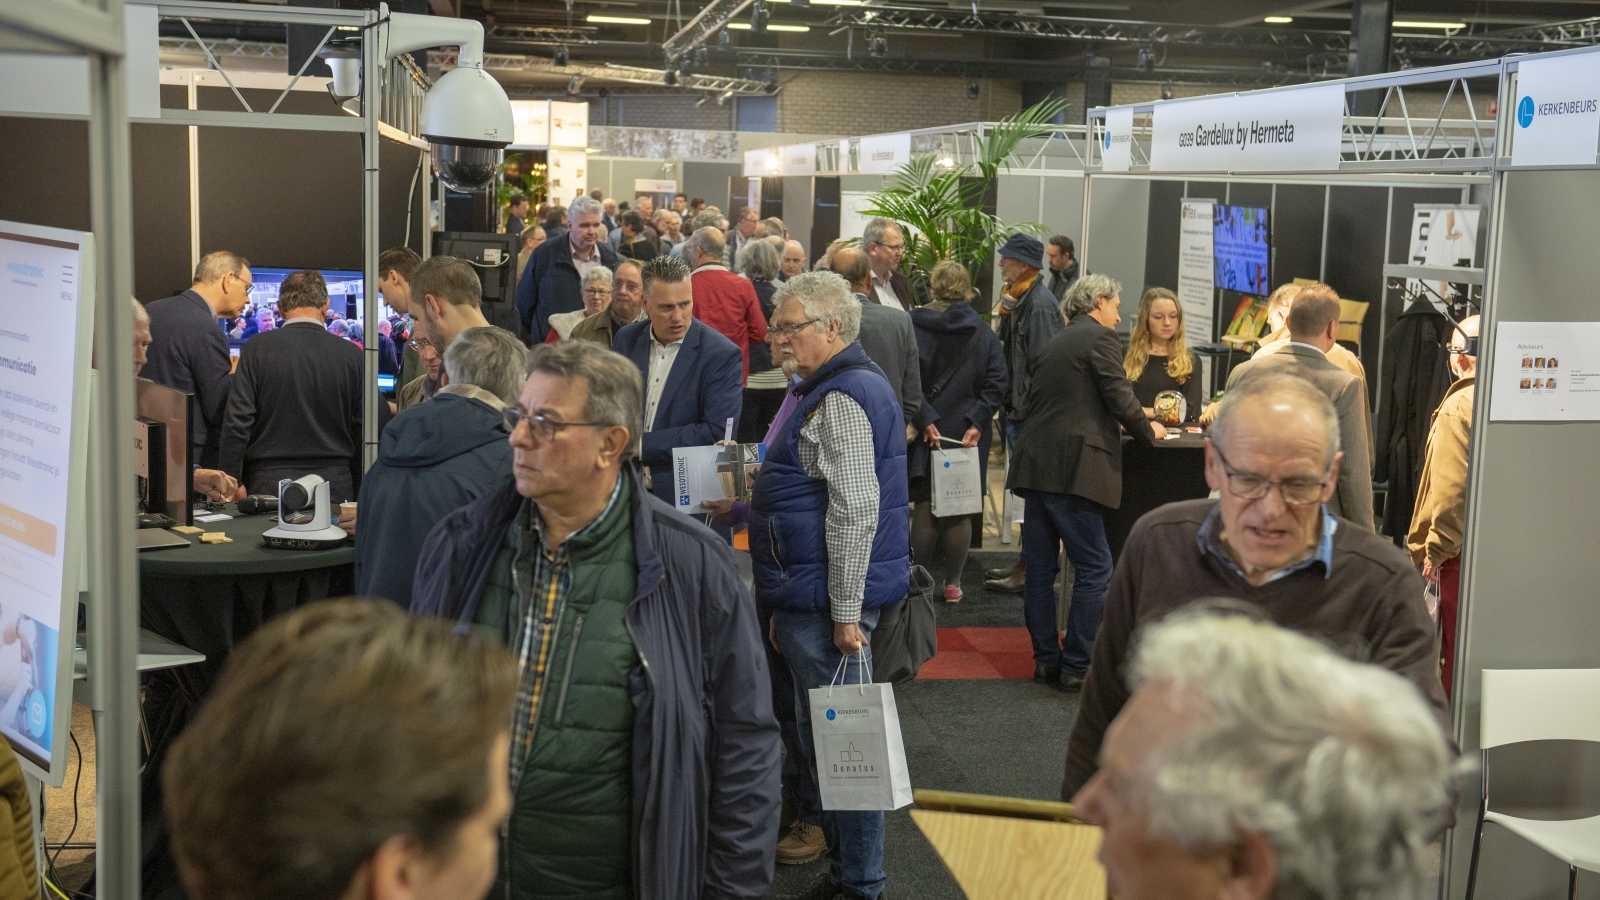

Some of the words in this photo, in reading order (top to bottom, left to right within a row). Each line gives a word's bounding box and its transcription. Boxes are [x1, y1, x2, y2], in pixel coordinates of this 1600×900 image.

[1538, 100, 1597, 116] KERKENBEURS
[1179, 132, 1194, 148] G039
[1195, 122, 1234, 147] Gardelux
[1236, 121, 1248, 151] by
[1249, 119, 1294, 144] Hermeta
[60, 291, 73, 302] MENU
[677, 456, 687, 495] WESOTRONIC
